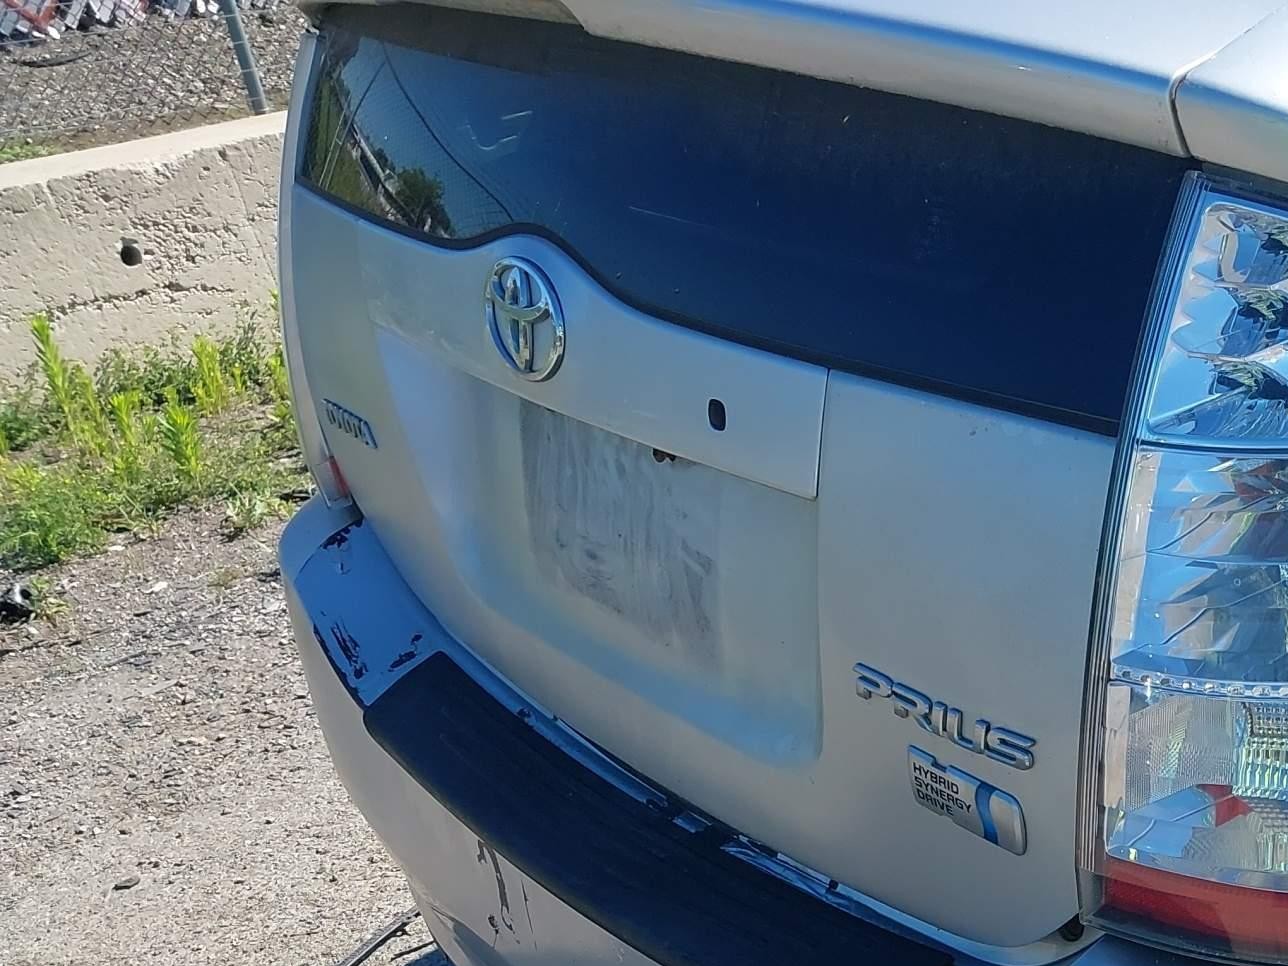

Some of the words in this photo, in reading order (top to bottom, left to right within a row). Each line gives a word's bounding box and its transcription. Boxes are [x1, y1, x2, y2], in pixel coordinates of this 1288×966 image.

[852, 662, 1036, 770] PRIUS
[912, 762, 959, 795] HYBRID
[914, 776, 971, 813] SYNERGY
[916, 788, 954, 816] DRIVE
